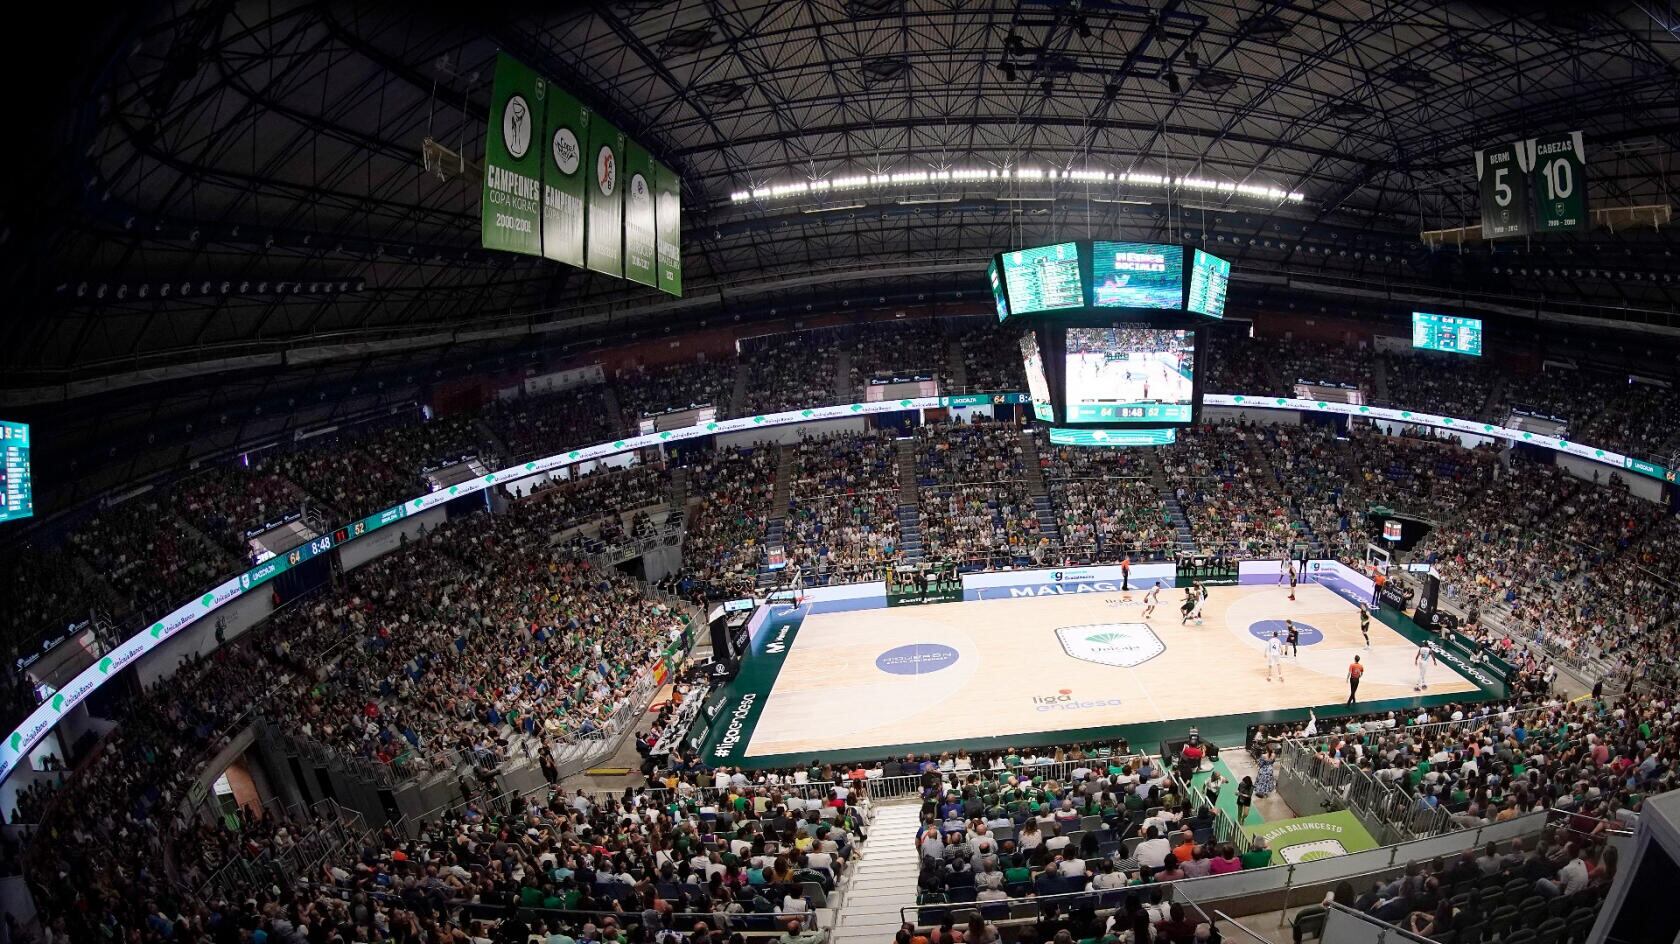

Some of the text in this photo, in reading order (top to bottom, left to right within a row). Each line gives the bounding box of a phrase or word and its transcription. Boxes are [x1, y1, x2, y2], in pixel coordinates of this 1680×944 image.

[1537, 141, 1572, 156] CABEZAS
[488, 164, 540, 202] CAMPEONES
[1542, 158, 1574, 200] 10
[1494, 168, 1512, 207] 5
[490, 190, 511, 208] COPA
[994, 395, 1005, 404] 64
[1122, 408, 1143, 417] 8:48
[290, 552, 300, 564] 64
[312, 537, 330, 555] 8:48
[354, 522, 364, 535] 52
[1032, 695, 1072, 704] liga
[1036, 700, 1121, 712] endesa
[714, 694, 756, 757] #ligaendesa
[1286, 822, 1342, 833] BALONCESTO
